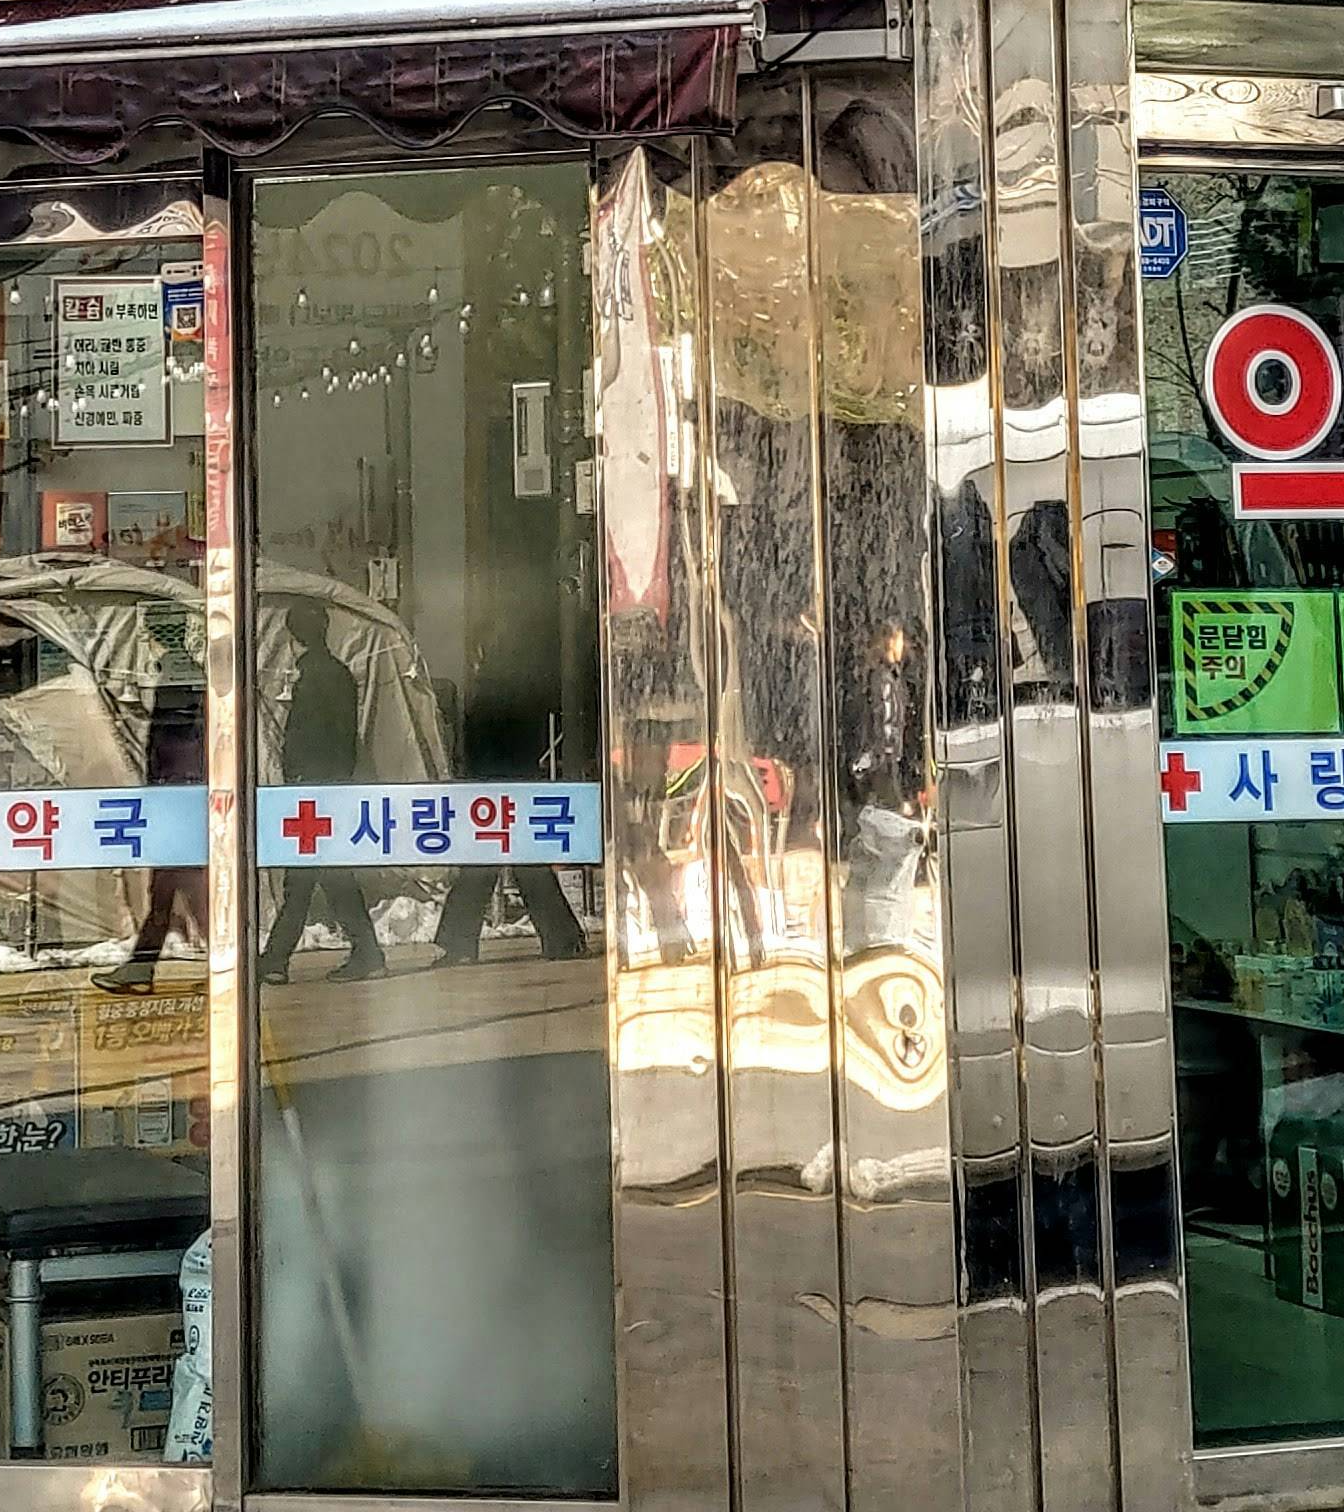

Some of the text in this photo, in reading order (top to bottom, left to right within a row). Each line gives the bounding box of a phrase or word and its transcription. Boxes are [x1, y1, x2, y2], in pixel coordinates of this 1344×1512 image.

[1198, 624, 1268, 651] 문닫힘
[1201, 654, 1248, 681] 주의
[349, 794, 577, 855] 사랑약국
[22, 1121, 65, 1152] 눈?
[87, 1364, 173, 1394] 안티푸라
